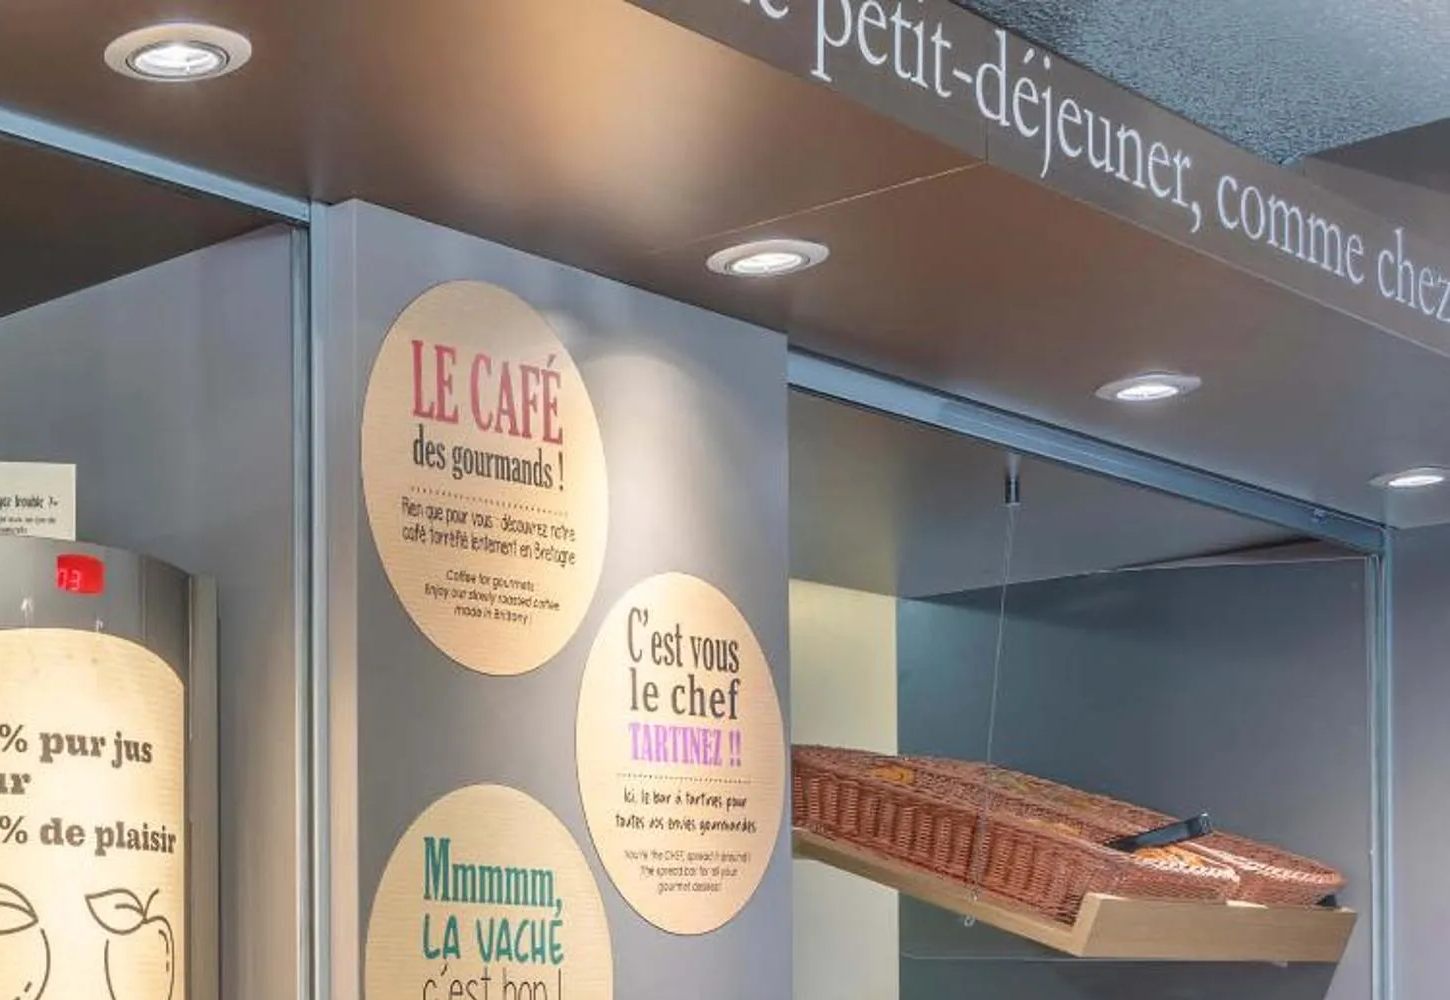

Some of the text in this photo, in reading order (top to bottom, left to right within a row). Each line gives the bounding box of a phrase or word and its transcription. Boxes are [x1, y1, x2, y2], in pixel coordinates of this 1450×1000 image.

[810, 0, 1450, 323] petit-déjeuner, comme chez
[411, 339, 563, 445] LE CAFÉ
[413, 423, 564, 491] des gourmands !
[627, 606, 740, 674] C'est vous
[629, 666, 742, 720] le chef
[39, 731, 106, 763] pur
[111, 730, 153, 769] jus
[628, 721, 722, 767] TARTINEZ
[39, 817, 87, 847] de
[94, 820, 177, 857] plaisir
[423, 913, 564, 966] LA VACHE
